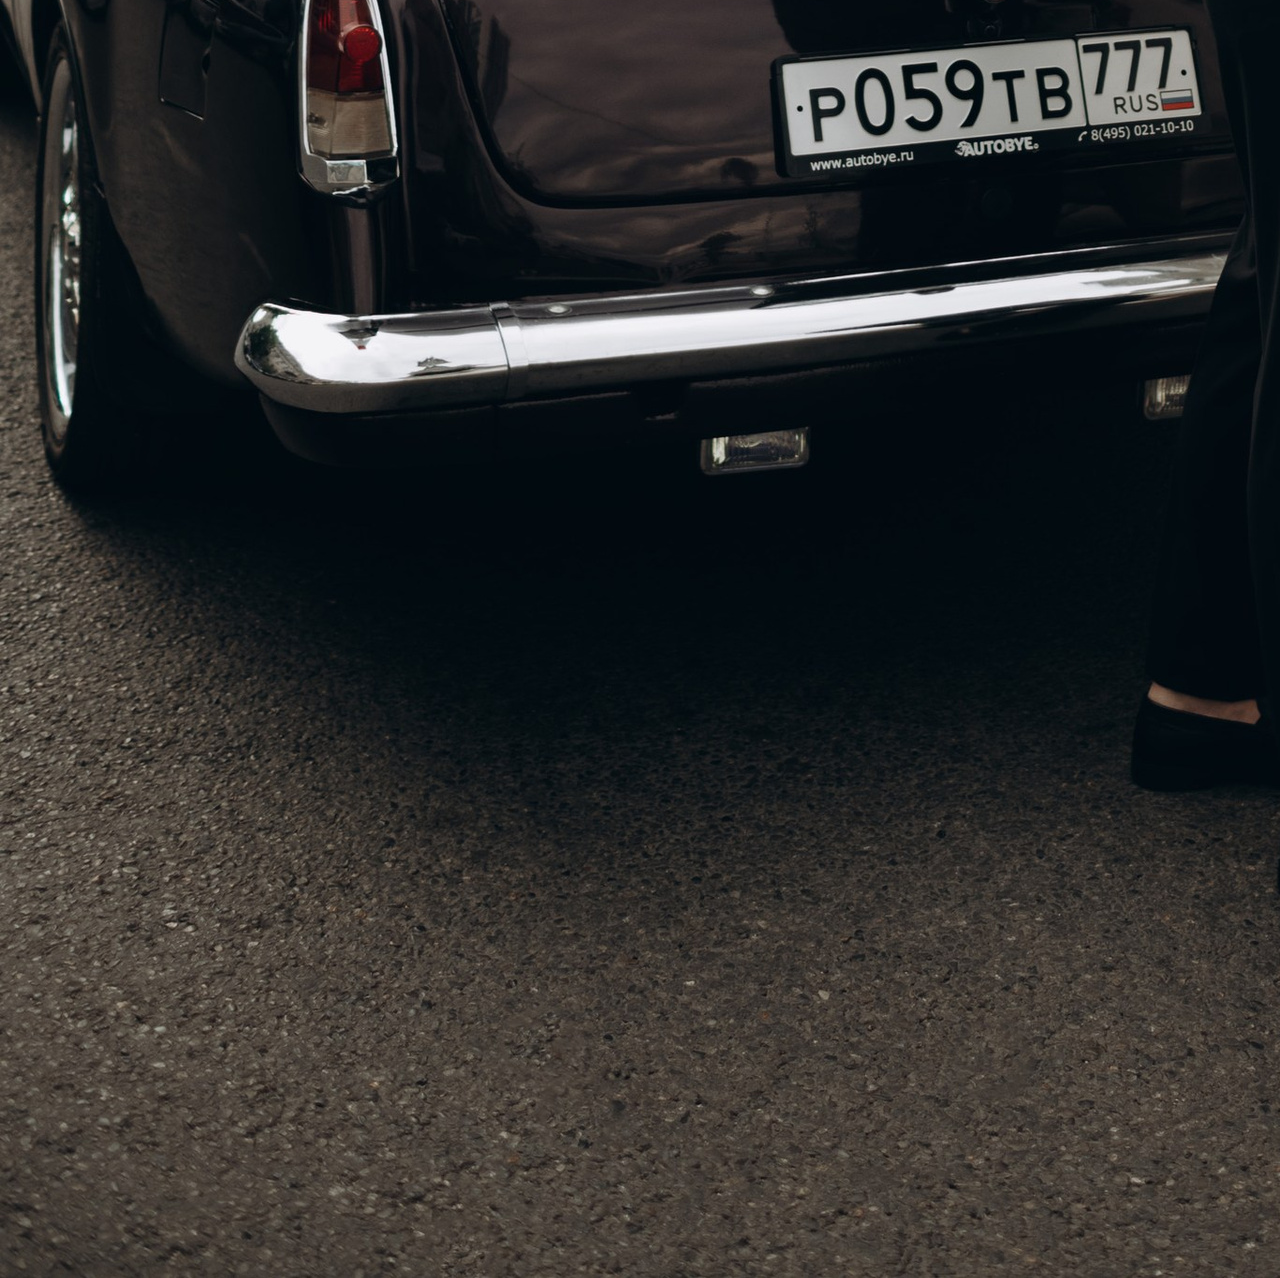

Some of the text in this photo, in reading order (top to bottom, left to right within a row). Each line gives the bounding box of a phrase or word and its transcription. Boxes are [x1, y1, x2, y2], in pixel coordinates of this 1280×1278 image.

[1082, 37, 1174, 96] 777
[1113, 93, 1159, 115] RUS
[1091, 119, 1194, 143] 8(495) 021-10-10
[964, 136, 1034, 157] AUTOBYE
[810, 151, 914, 171] www.autobye.ru
